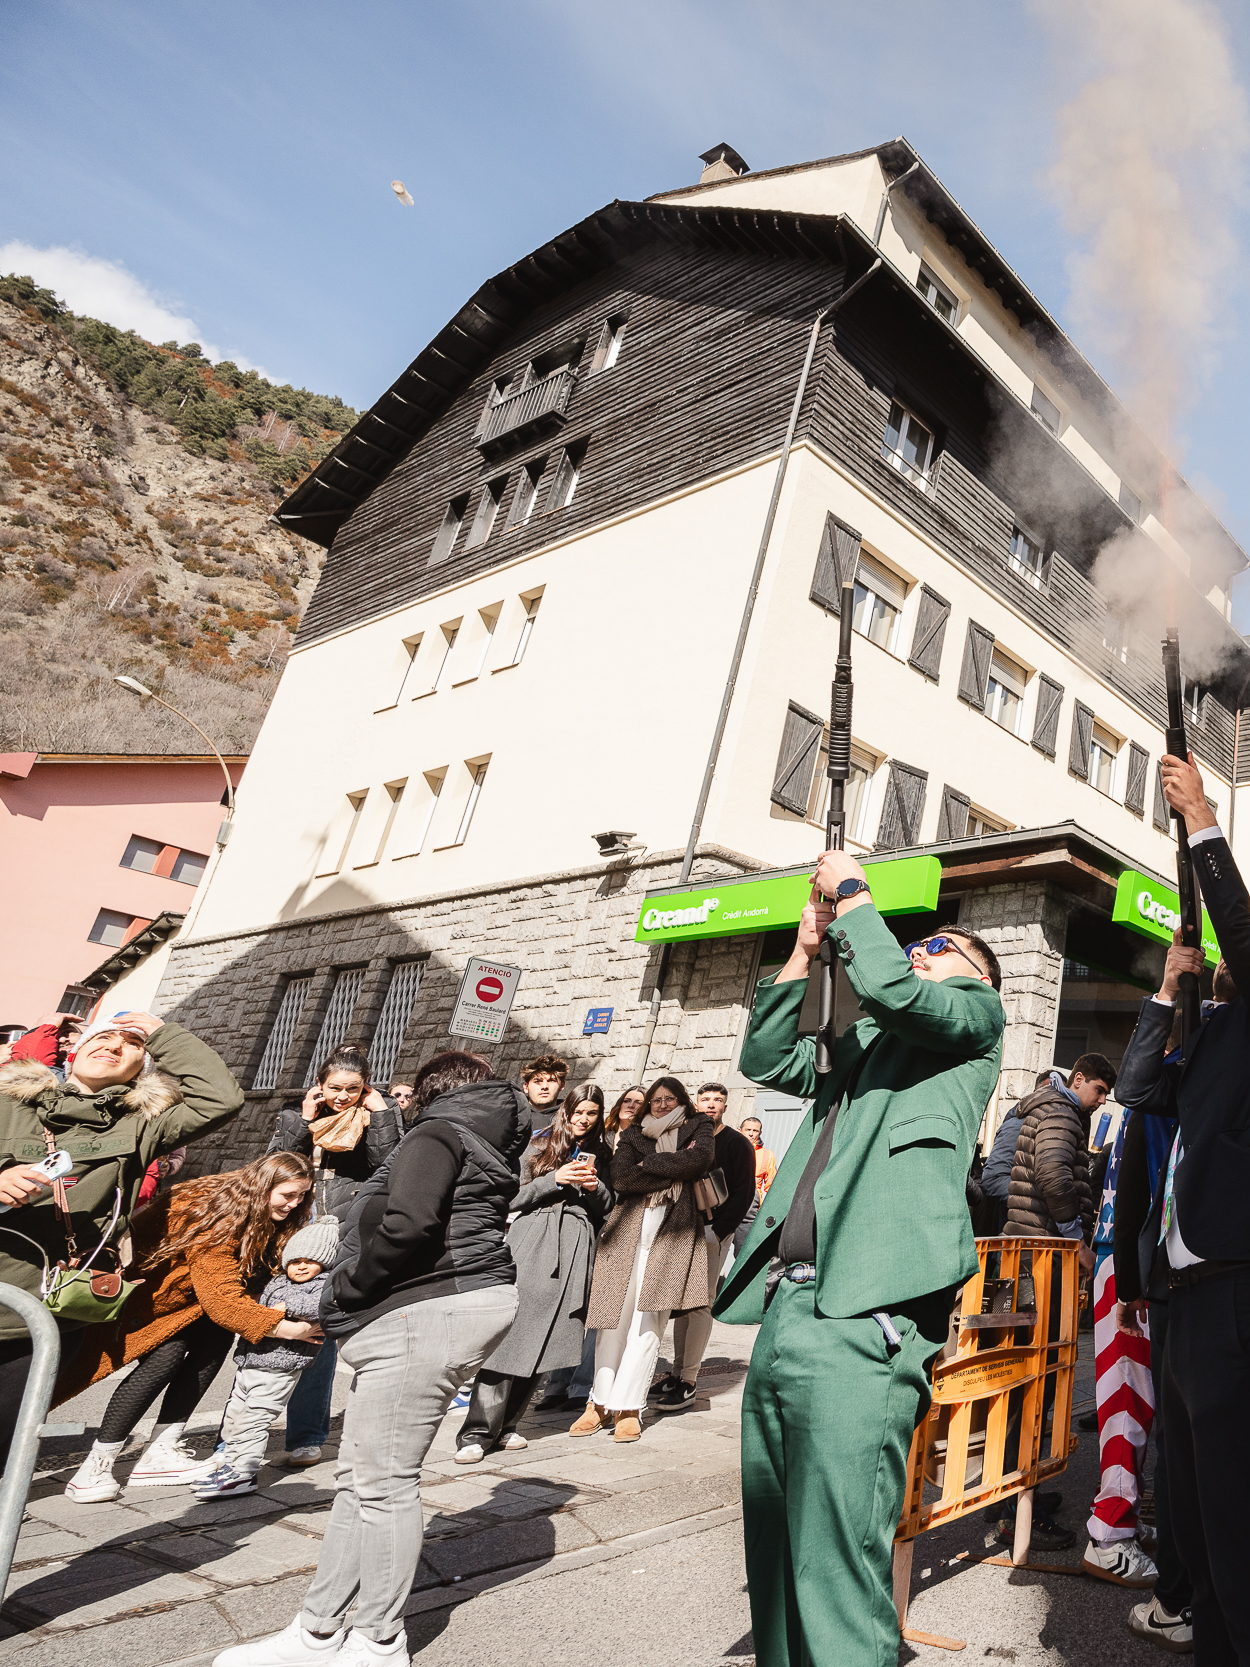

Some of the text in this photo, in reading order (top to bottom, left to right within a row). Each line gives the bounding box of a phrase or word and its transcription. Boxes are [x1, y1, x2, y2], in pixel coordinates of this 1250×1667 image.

[642, 898, 708, 931] Creand
[722, 906, 769, 920] Crèdit Andorrà
[1137, 891, 1181, 932] Crean
[477, 965, 512, 978] ATENCIÓ
[461, 1000, 476, 1008] Carrer
[951, 1367, 981, 1379] DEPARTAMENT
[989, 1362, 1004, 1370] SERVEIS
[1005, 1357, 1025, 1366] GENERALS
[963, 1375, 985, 1386] DISCULPEU
